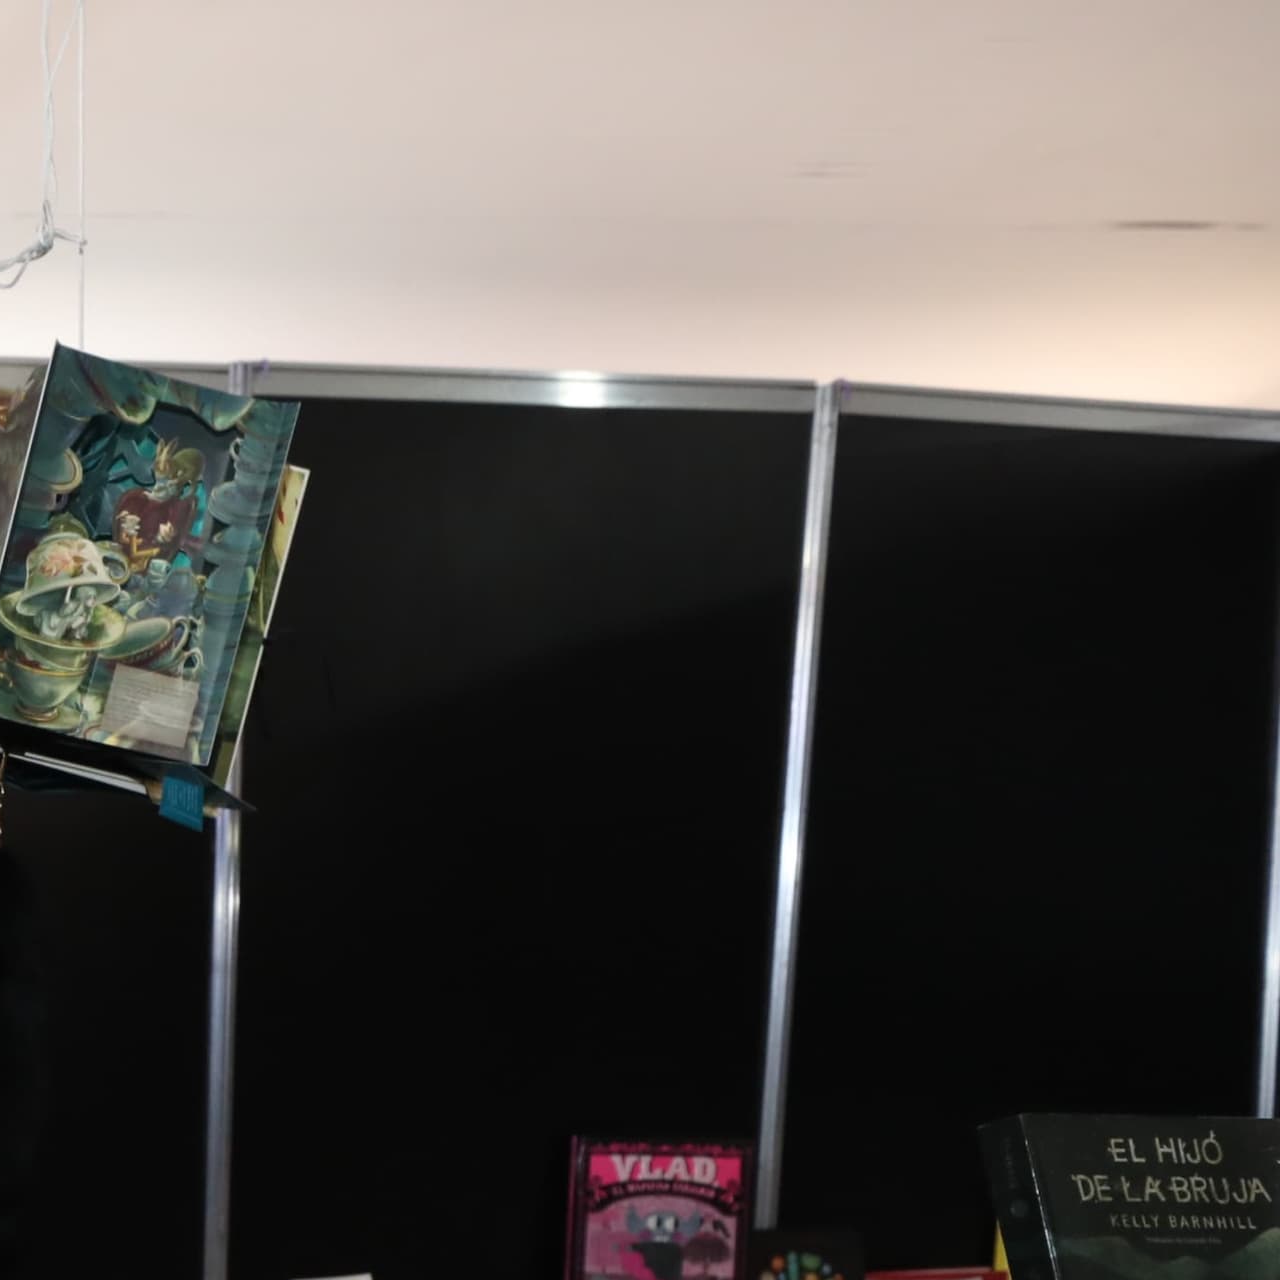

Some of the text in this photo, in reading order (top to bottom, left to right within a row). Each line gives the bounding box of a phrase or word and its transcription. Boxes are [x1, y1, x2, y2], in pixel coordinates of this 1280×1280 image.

[1169, 1174, 1272, 1204] BRUJA
[1110, 1215, 1257, 1230] KELLY BARNHILL
